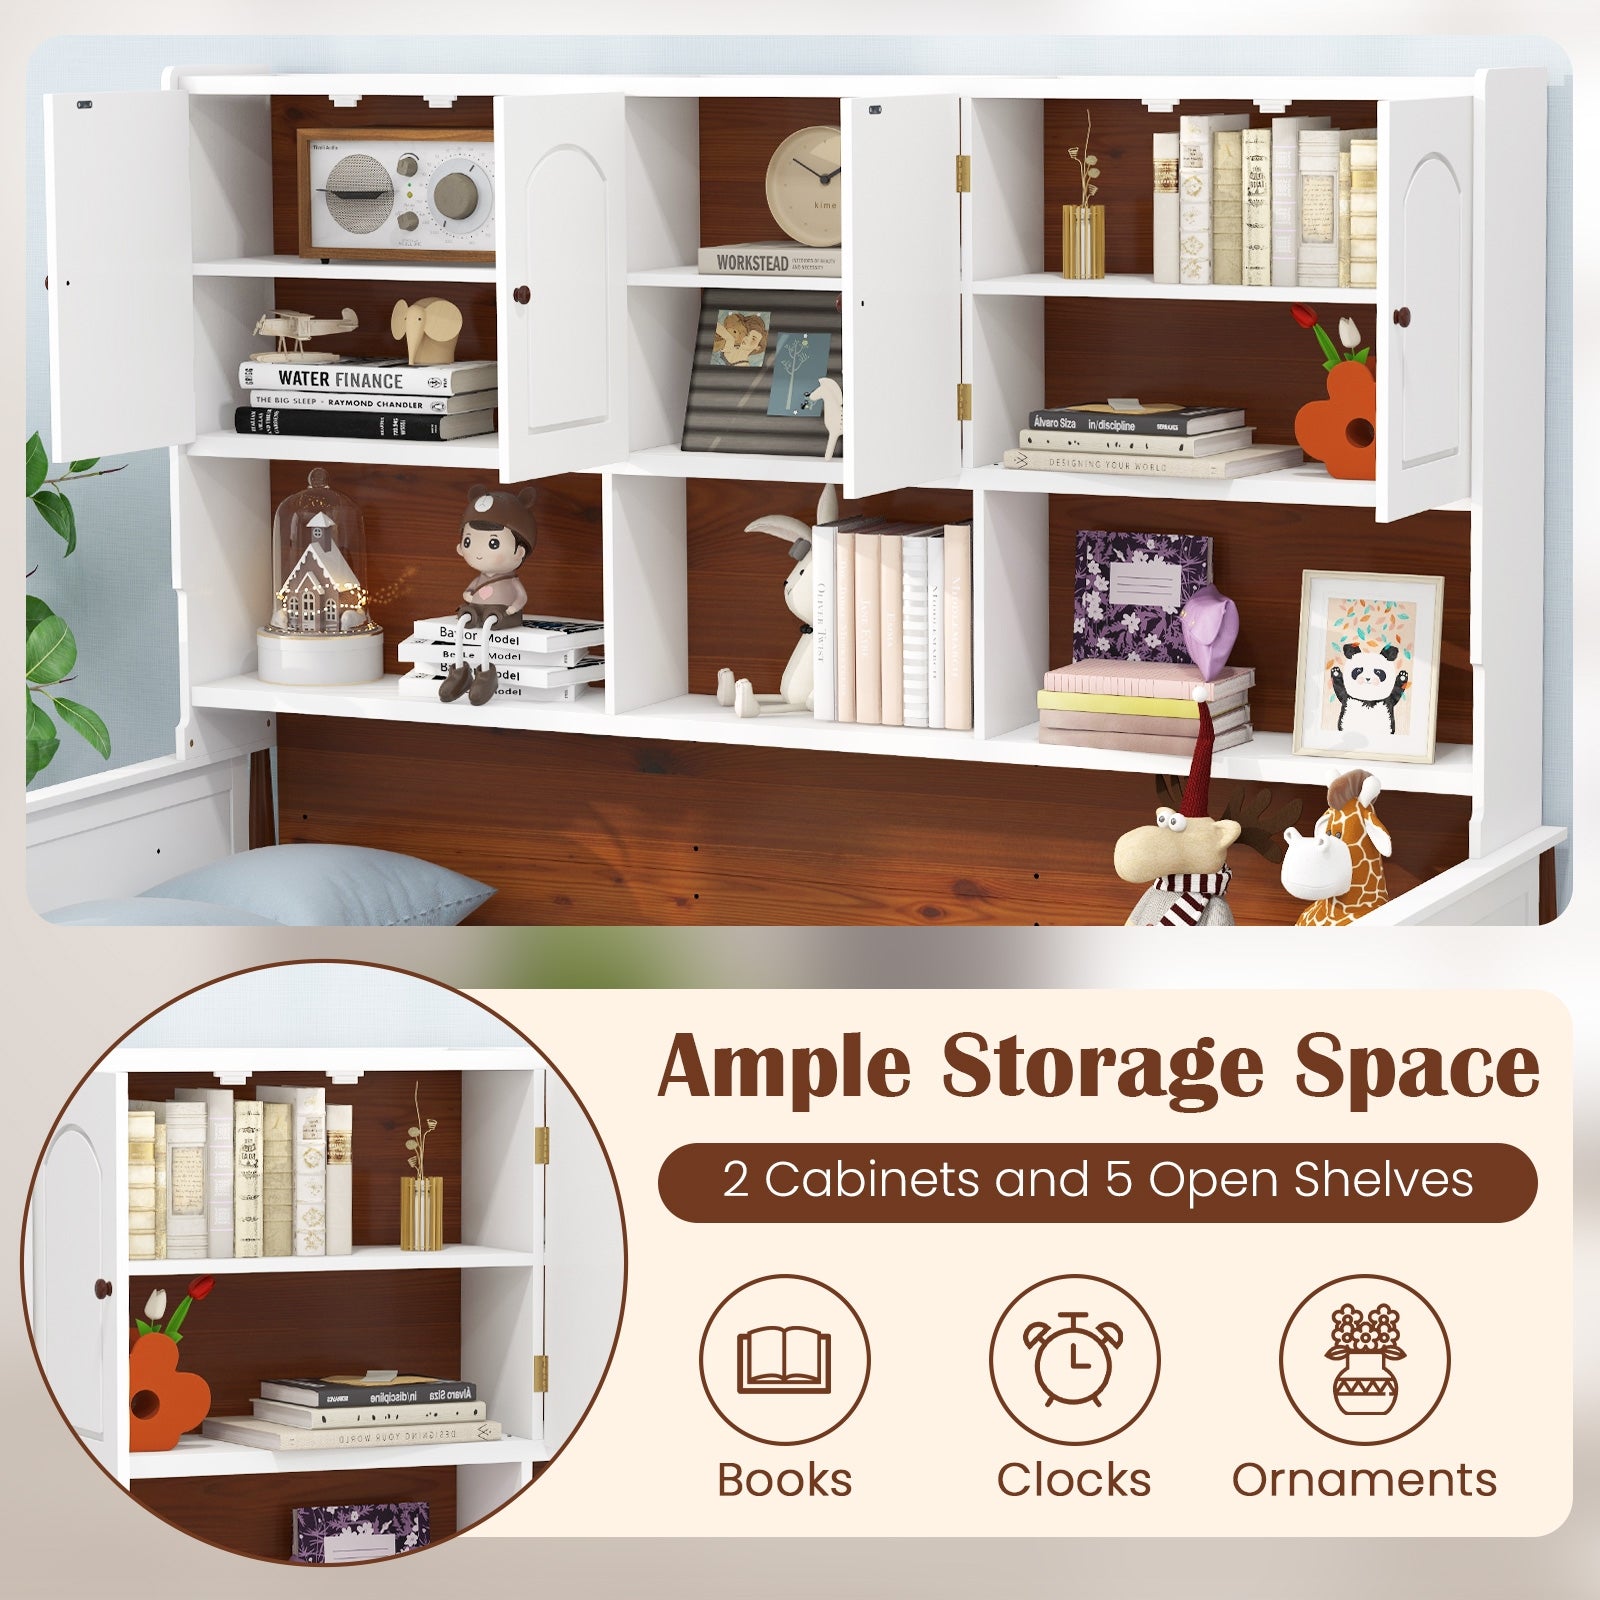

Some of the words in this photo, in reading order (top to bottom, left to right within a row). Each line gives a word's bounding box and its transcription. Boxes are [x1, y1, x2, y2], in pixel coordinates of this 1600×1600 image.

[717, 254, 789, 271] WORKSTEAD
[278, 370, 330, 387] WATER
[335, 372, 403, 389] FINANCE
[328, 399, 374, 407] RAYMOND
[1034, 414, 1059, 428] Álvaro
[1059, 417, 1077, 429] Siza
[1088, 419, 1136, 432] in/discipline
[1049, 458, 1100, 468] DESIGNING
[1105, 461, 1130, 470] YOUR
[1134, 462, 1167, 471] WORLD
[497, 670, 520, 681] odel
[495, 688, 522, 696] odel
